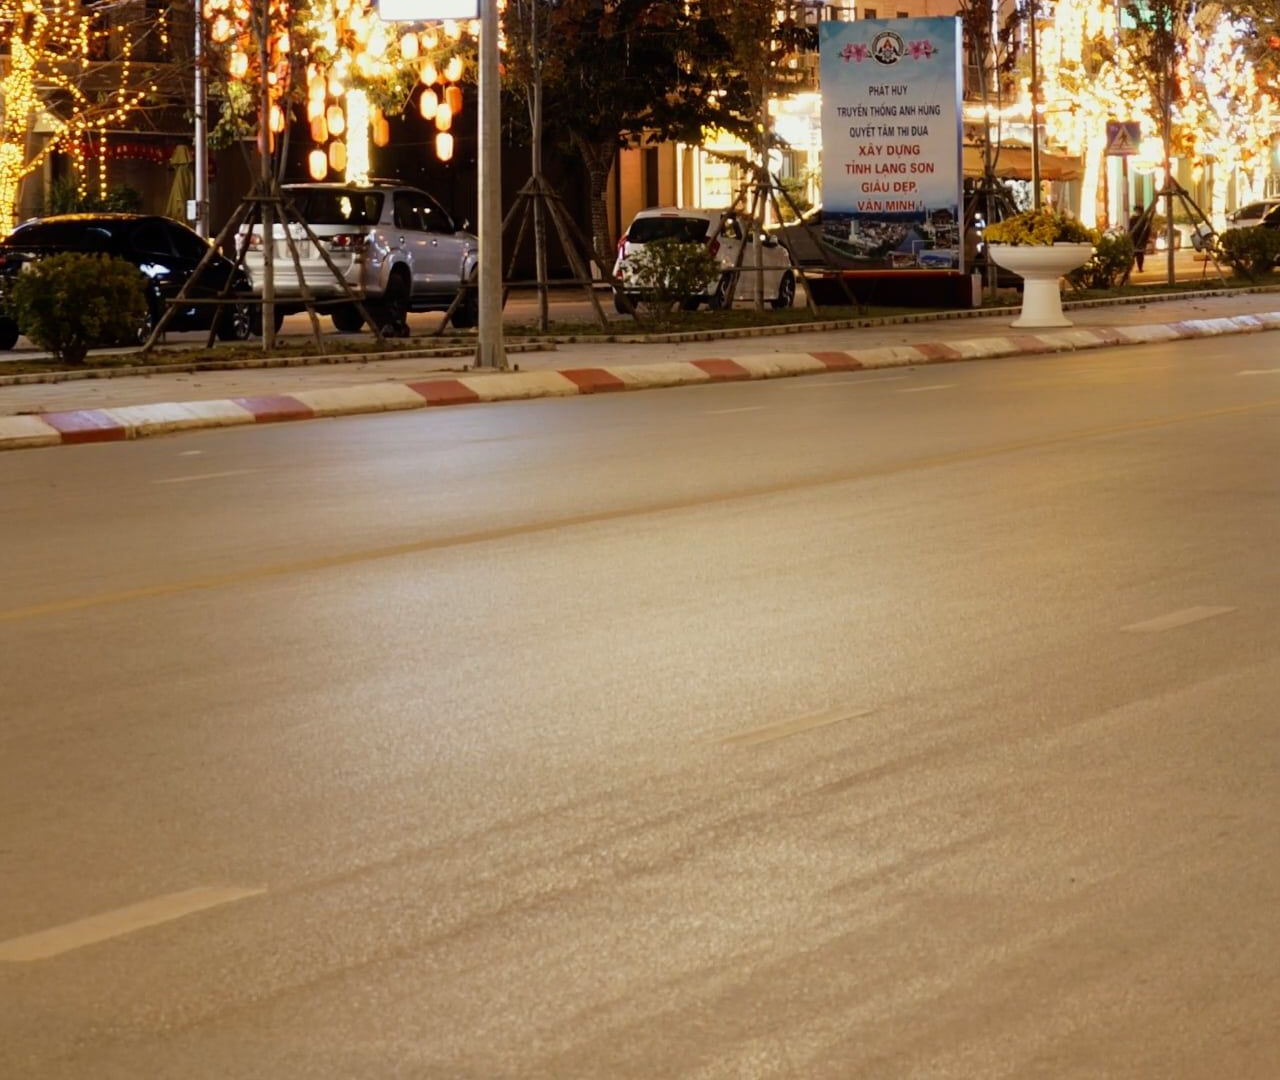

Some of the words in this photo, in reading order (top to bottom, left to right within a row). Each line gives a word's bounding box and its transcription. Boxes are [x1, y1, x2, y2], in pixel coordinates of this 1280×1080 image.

[891, 86, 907, 95] HUY
[899, 106, 916, 115] ANH
[898, 127, 908, 136] THI
[858, 143, 883, 156] XÂY
[875, 163, 907, 177] LẠNG
[910, 162, 935, 174] SƠN
[885, 200, 916, 212] MINH
